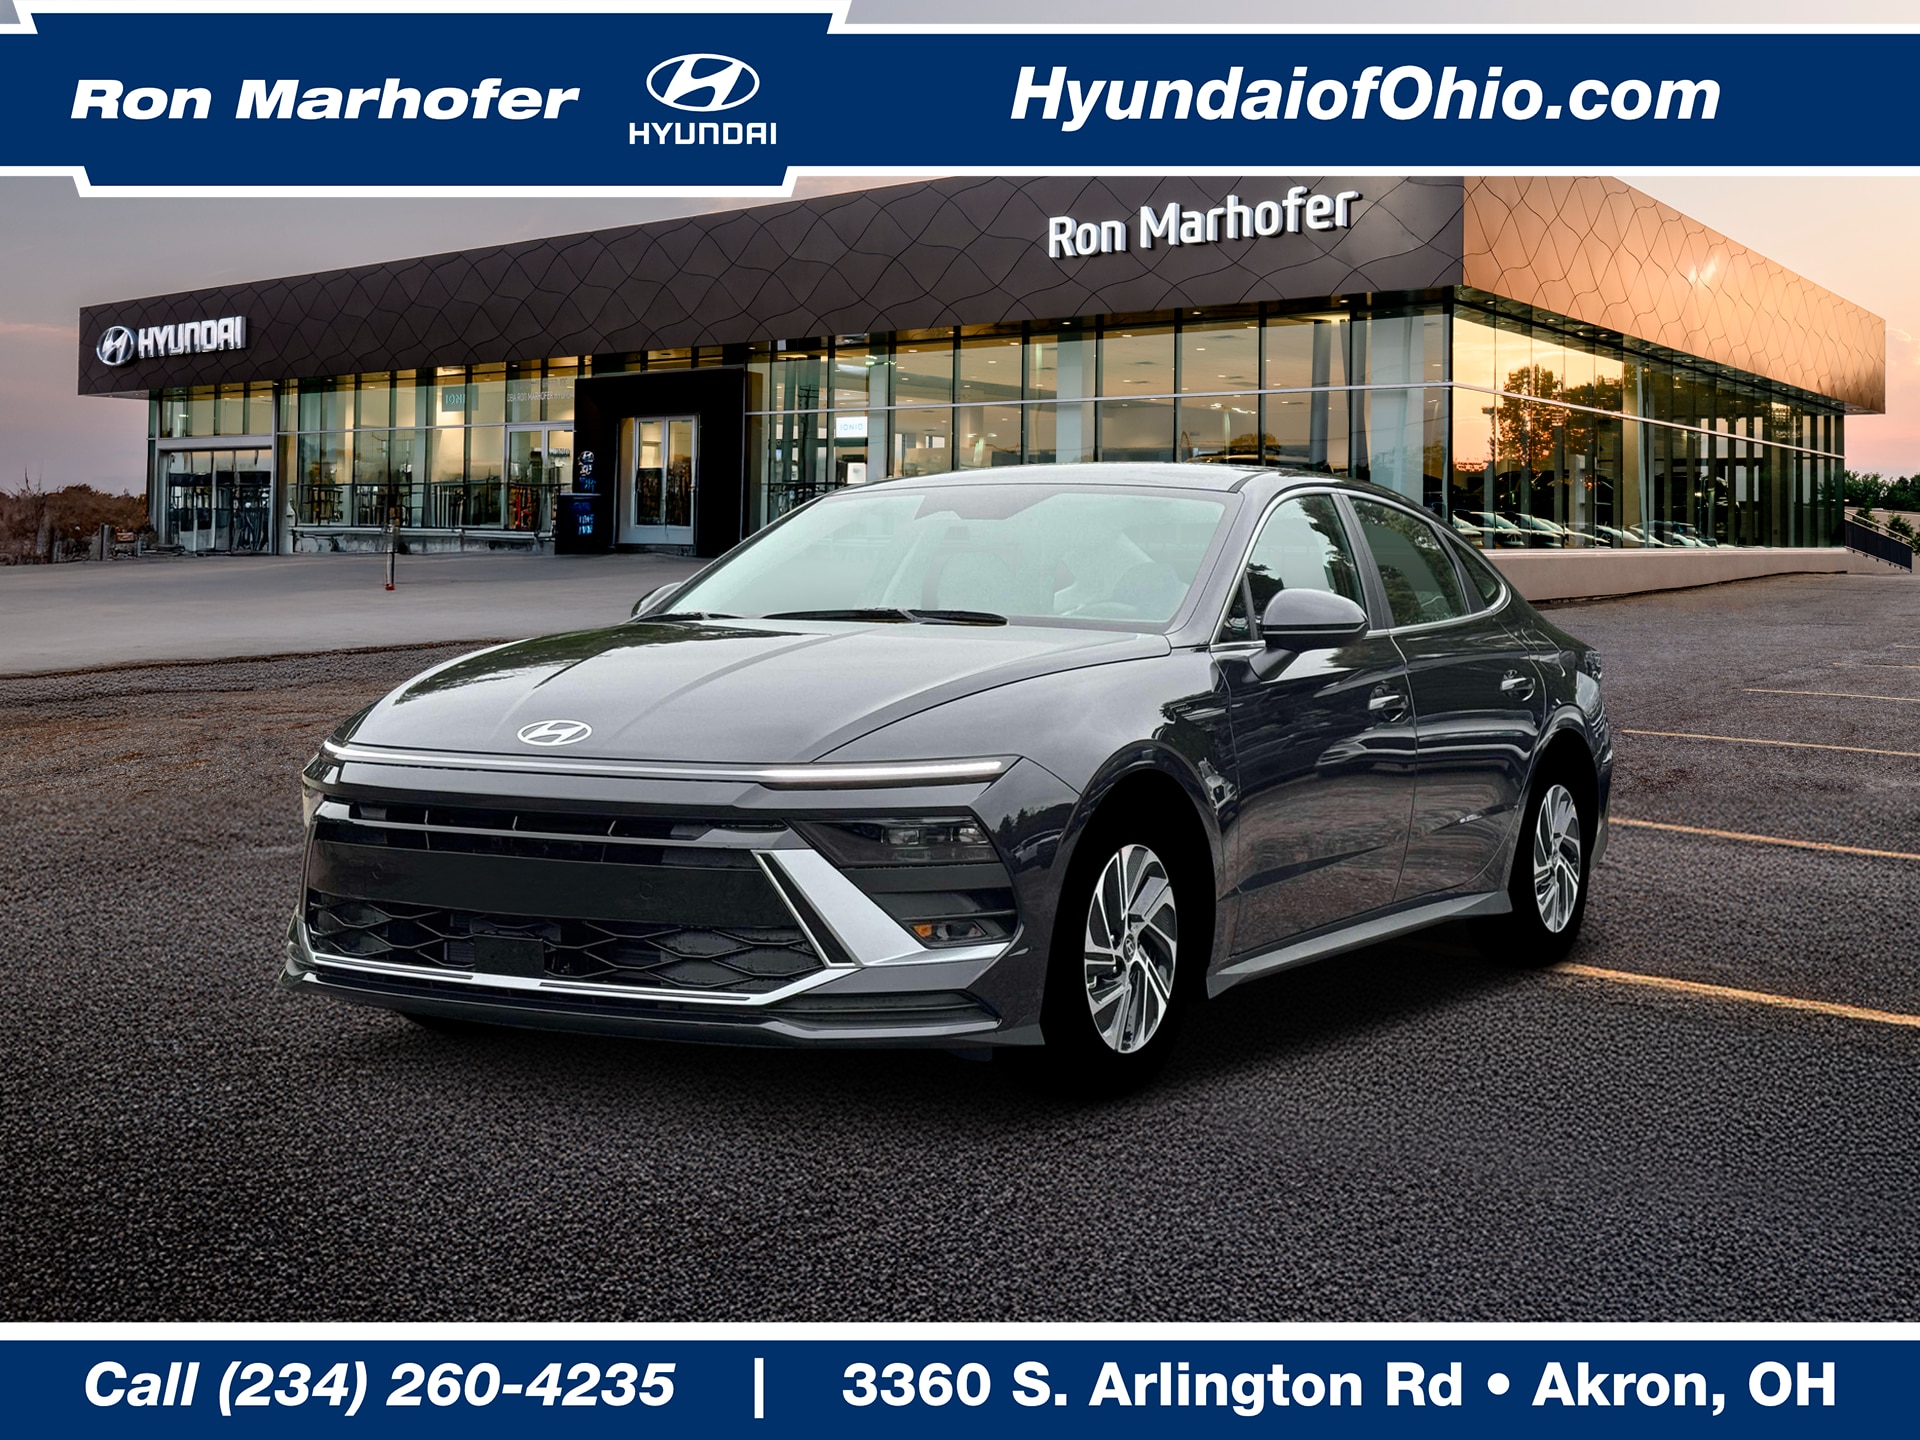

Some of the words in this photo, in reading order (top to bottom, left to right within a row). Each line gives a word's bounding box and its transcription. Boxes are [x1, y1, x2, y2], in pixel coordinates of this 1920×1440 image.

[1048, 214, 1126, 258] Ron
[1139, 185, 1361, 249] Marhofer
[138, 315, 247, 359] HYUNDAI
